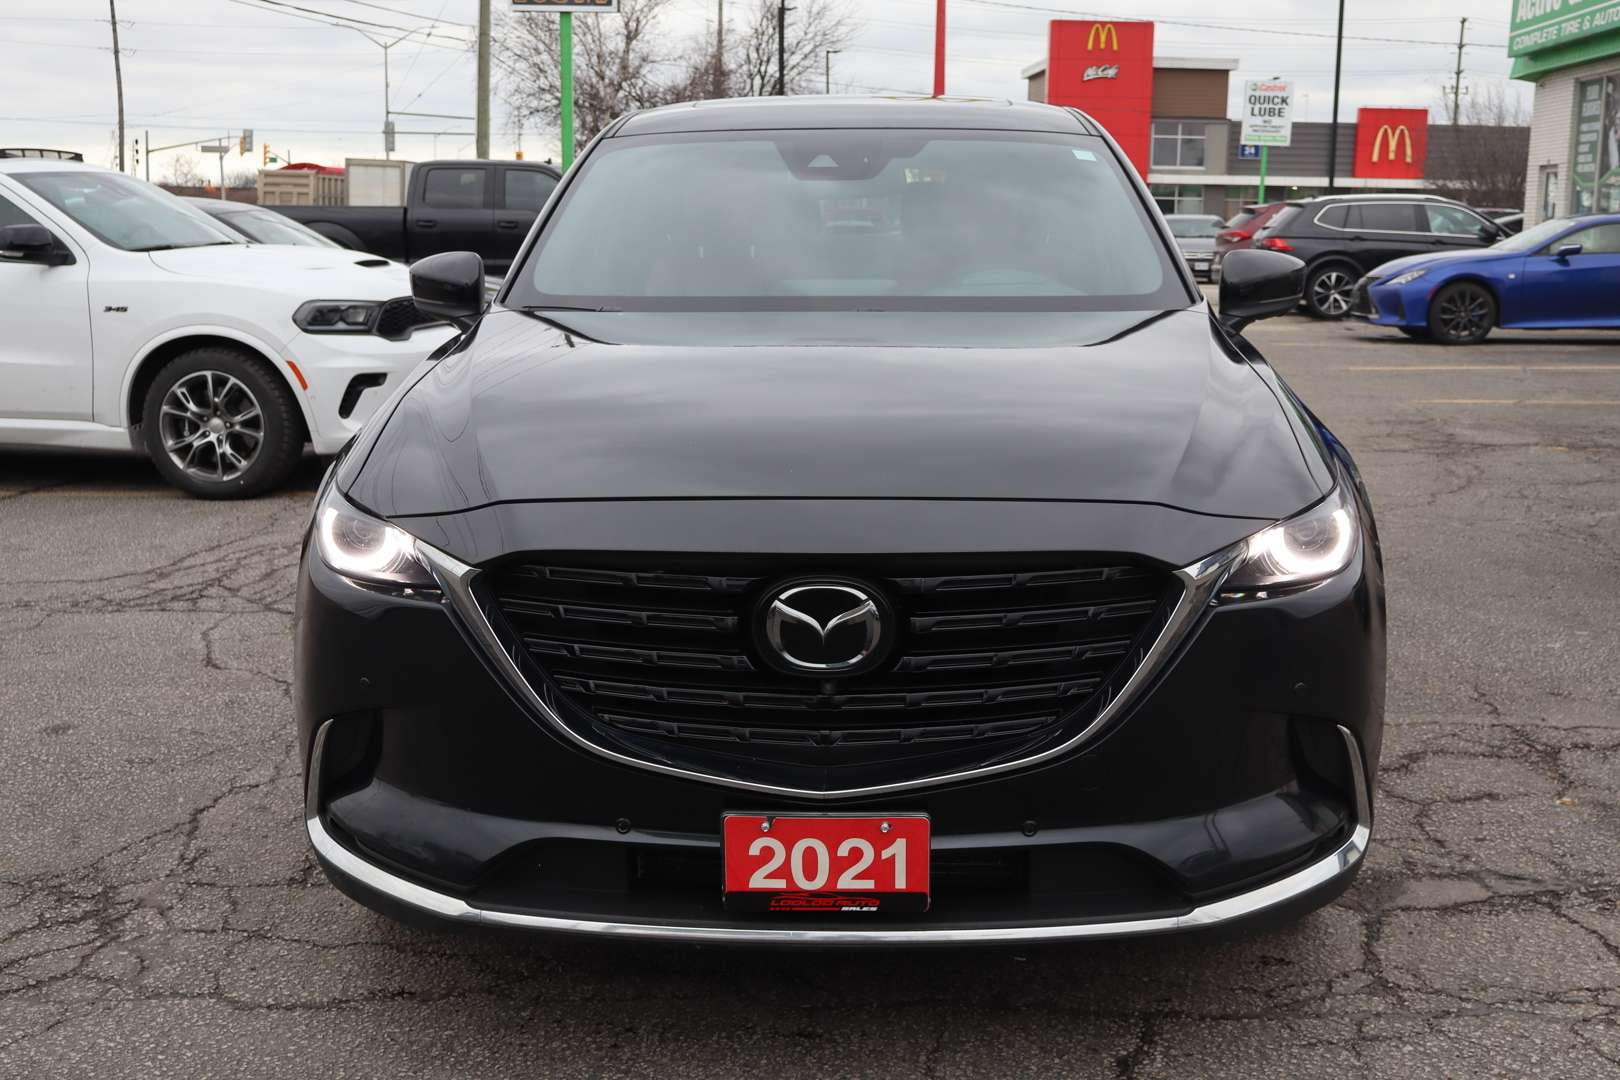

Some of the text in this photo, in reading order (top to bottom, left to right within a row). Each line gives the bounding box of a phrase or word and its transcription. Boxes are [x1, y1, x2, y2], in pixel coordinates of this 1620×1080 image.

[1513, 26, 1558, 49] COMPLETE
[1561, 19, 1581, 36] TIRE
[1248, 95, 1290, 106] QUICK
[1250, 106, 1286, 118] LUBE
[748, 837, 907, 890] 2021
